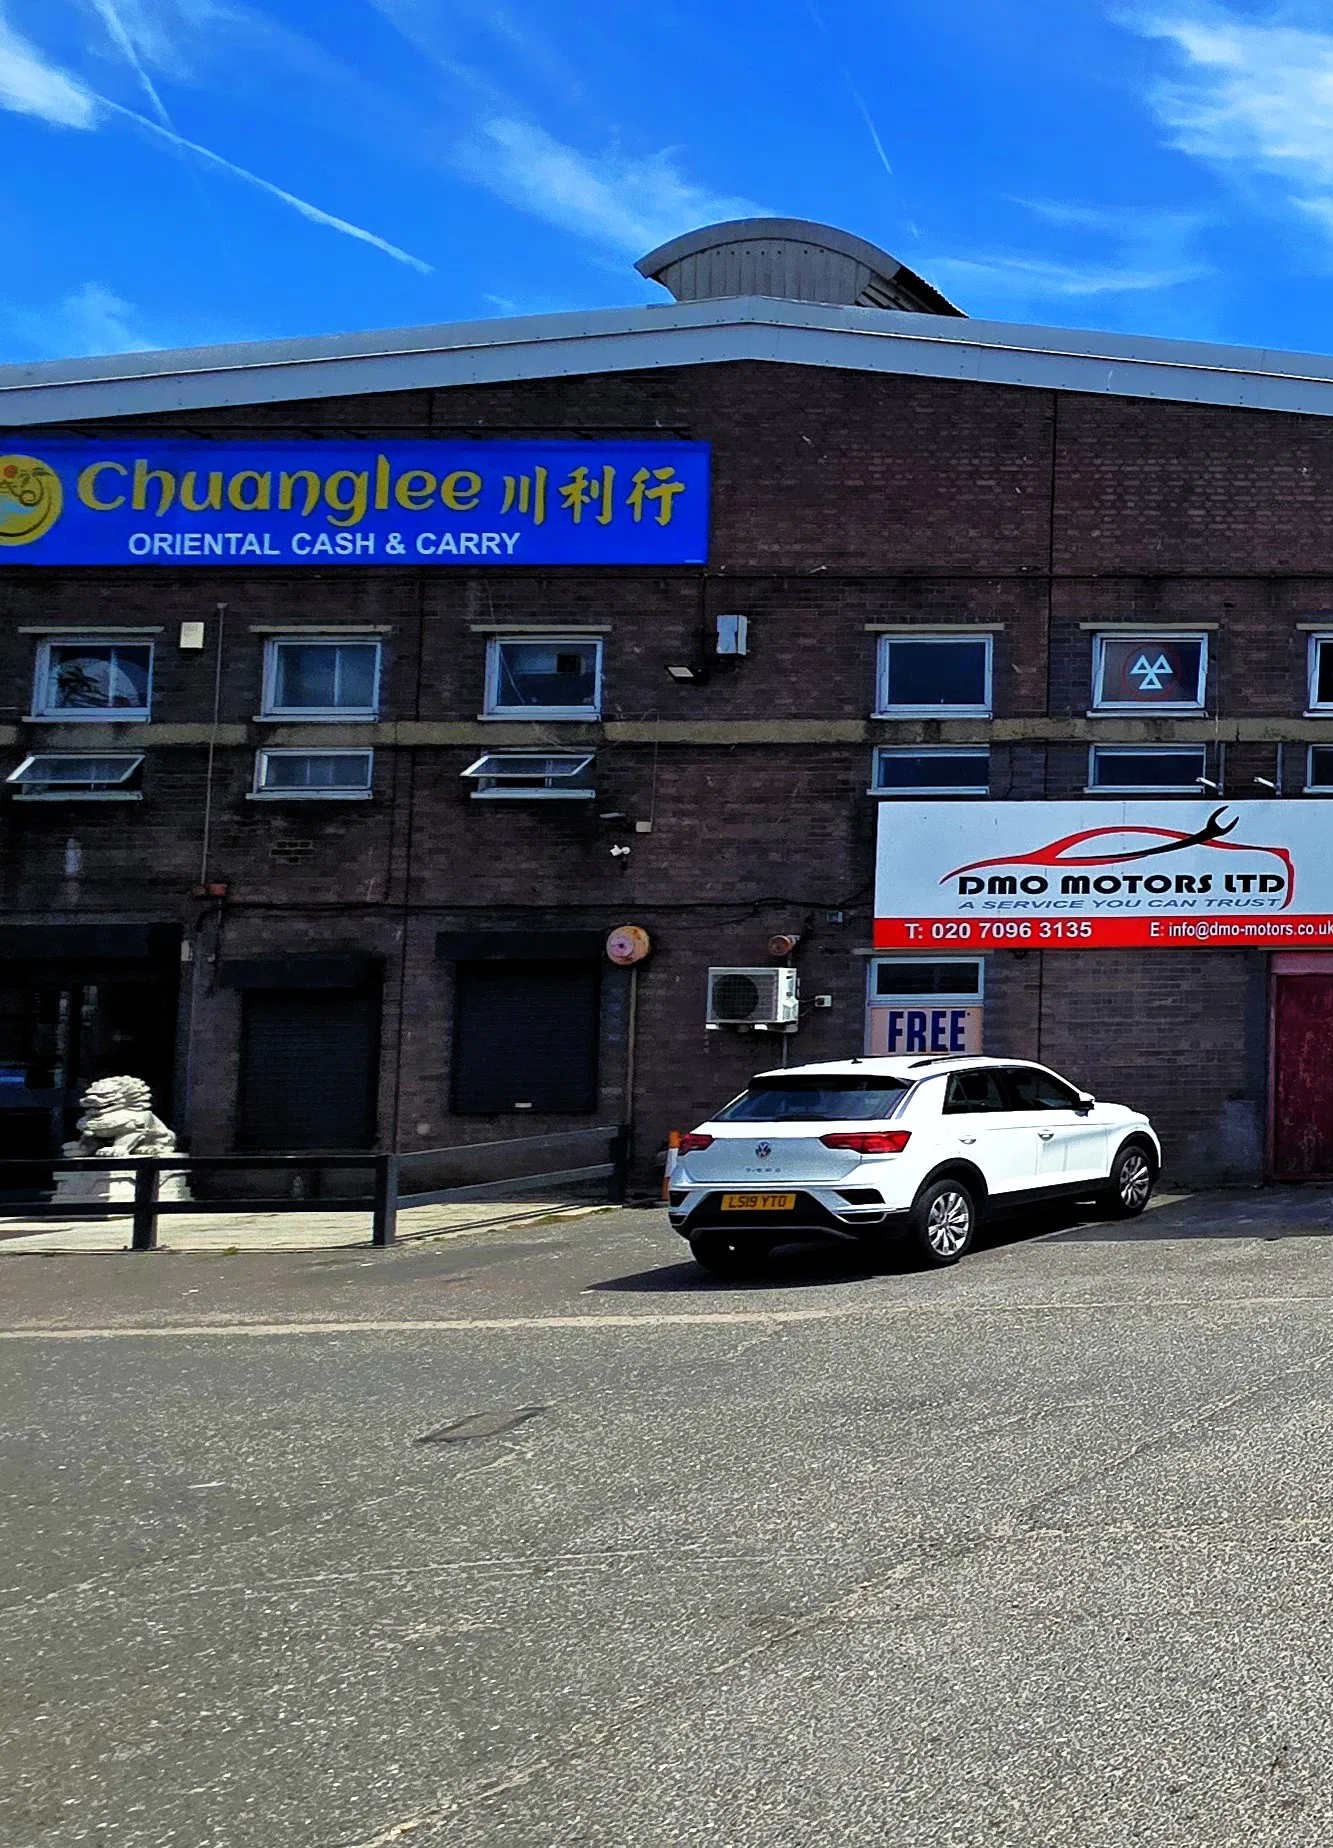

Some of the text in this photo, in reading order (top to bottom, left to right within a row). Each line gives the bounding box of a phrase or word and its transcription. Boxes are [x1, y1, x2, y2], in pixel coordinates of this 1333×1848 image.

[77, 454, 483, 527] Chuanglee
[499, 465, 686, 526] 川利行
[128, 532, 521, 555] ORIENTAL CASH & CARRY
[958, 874, 1286, 895] DMO MOTORS LTD
[957, 898, 1282, 910] A SERVICE YOU CAN TRUST
[904, 921, 1093, 939] T: 020 7096 3135
[1150, 921, 1165, 937] E:
